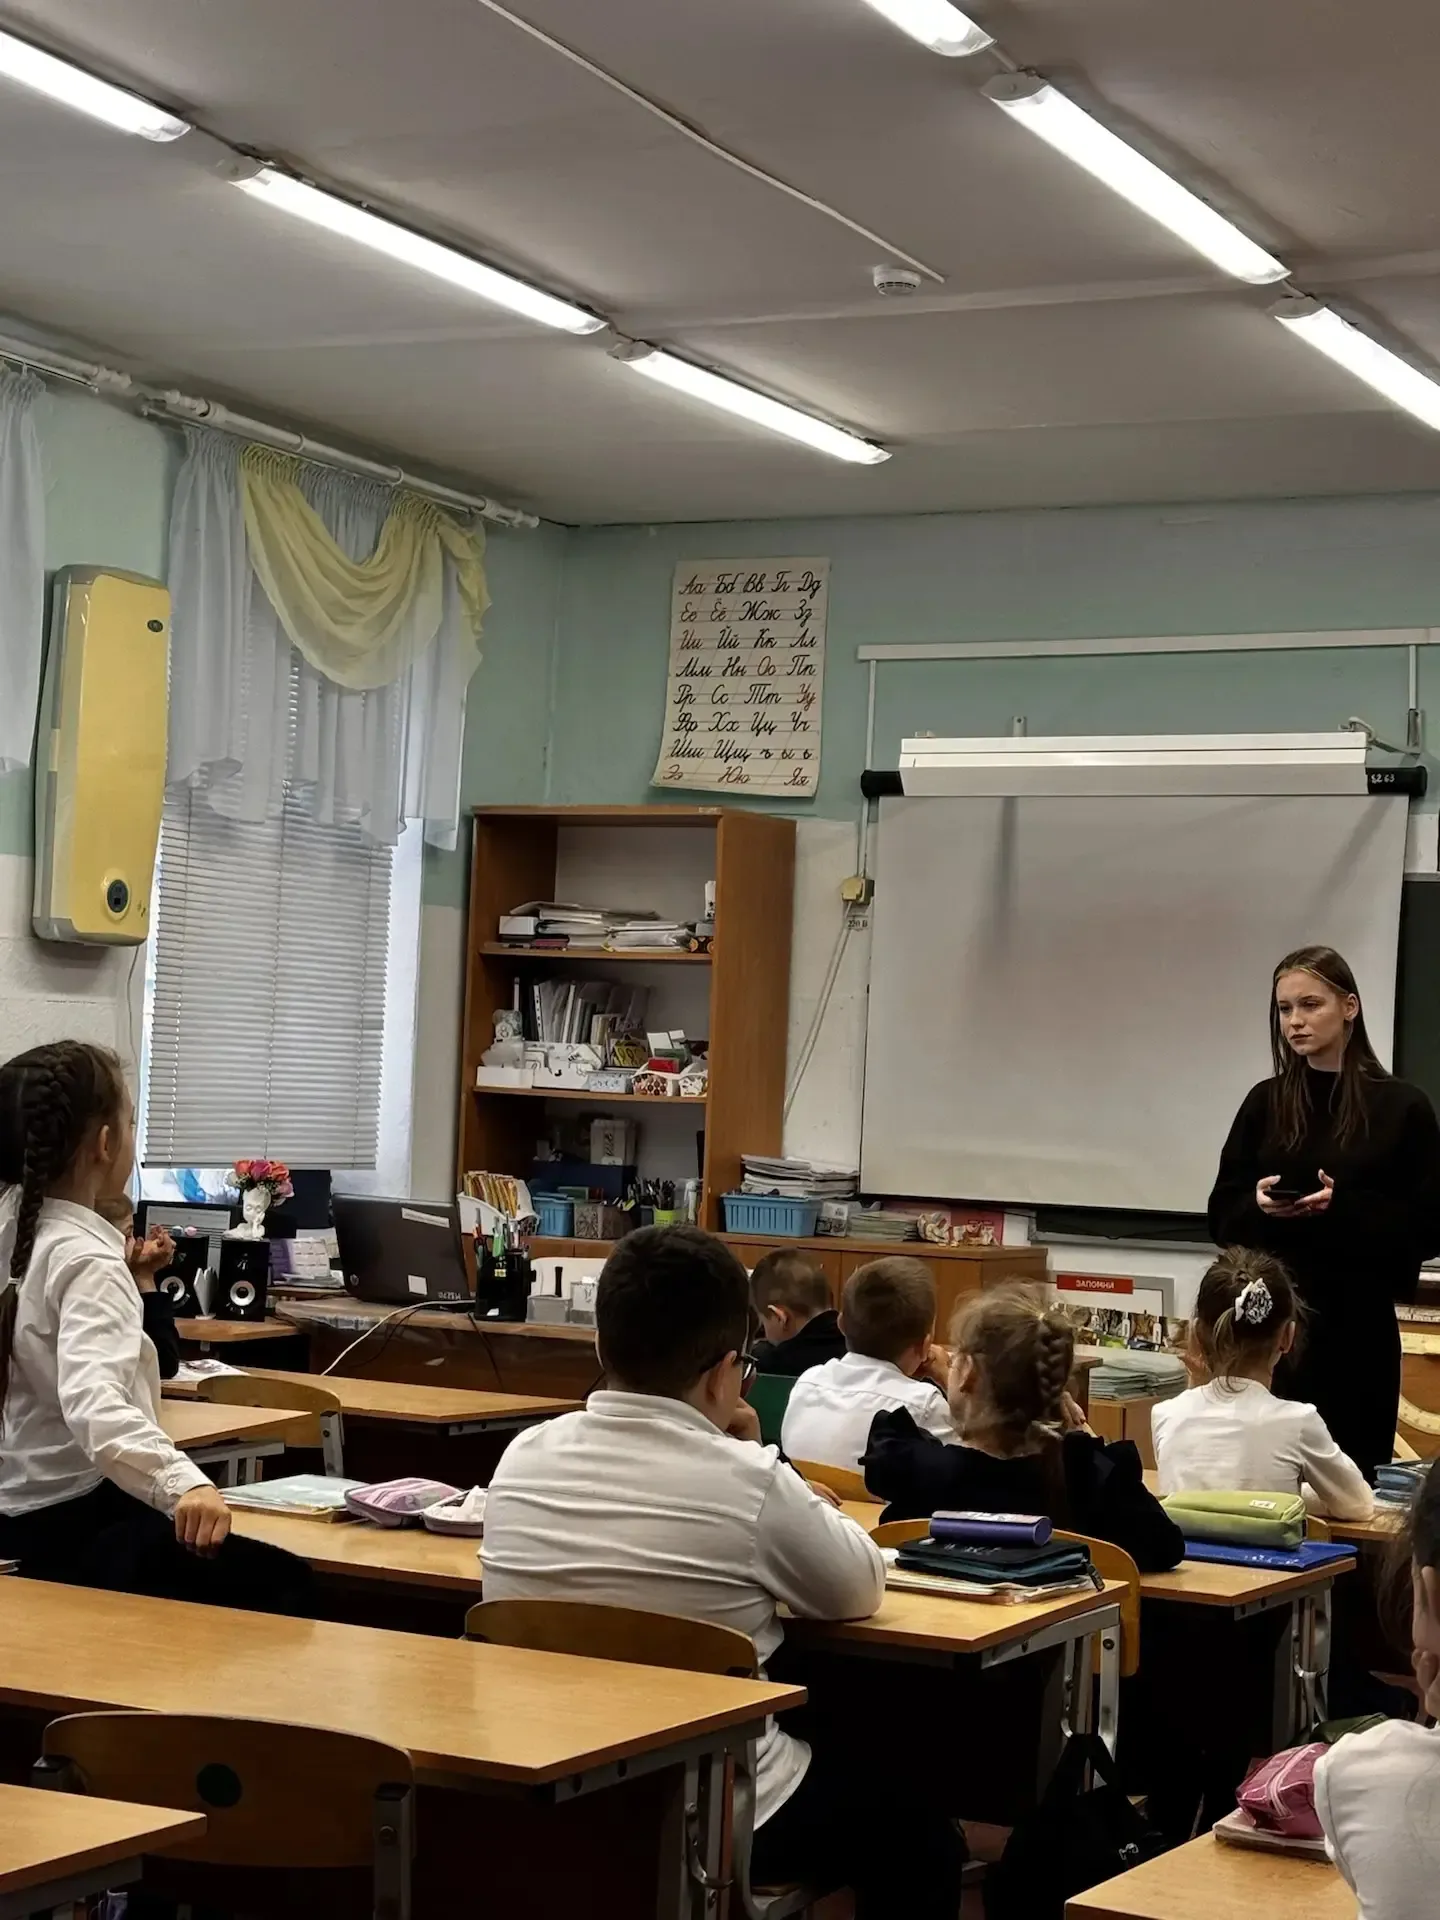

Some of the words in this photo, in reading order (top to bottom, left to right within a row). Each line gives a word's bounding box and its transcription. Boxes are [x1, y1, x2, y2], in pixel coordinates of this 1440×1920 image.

[679, 574, 706, 595] Аа
[715, 572, 745, 594] Бб
[743, 573, 766, 593] Вв
[771, 570, 793, 592] Гг
[797, 571, 822, 600] Дд
[680, 601, 698, 622] Ее
[710, 598, 728, 622] Ёё
[738, 600, 781, 621] Жж
[794, 598, 813, 628] Зз
[680, 628, 704, 650] Ии
[717, 625, 740, 649] Йй
[753, 628, 778, 648] Кк
[789, 627, 817, 648] Лл
[675, 656, 713, 677] Мм
[721, 656, 748, 677] Нн
[757, 655, 777, 676] Оо
[786, 654, 816, 676] Пп
[673, 683, 697, 713] Рр
[711, 683, 730, 704] Сс
[743, 683, 782, 704] Тт
[796, 683, 817, 712] Уу
[672, 712, 699, 739] Фф
[708, 711, 740, 732] Хх
[750, 711, 778, 737] Цц
[790, 711, 811, 732] Чч
[670, 738, 705, 758] Шш
[713, 738, 752, 763] Щщ
[760, 748, 774, 760] ъ
[781, 748, 795, 760] ы
[803, 748, 813, 760] ь
[662, 763, 684, 780] Ээ
[717, 765, 751, 784] Юю
[783, 766, 810, 786] Яя
[1075, 1279, 1115, 1289] ЗАПОМНИ
